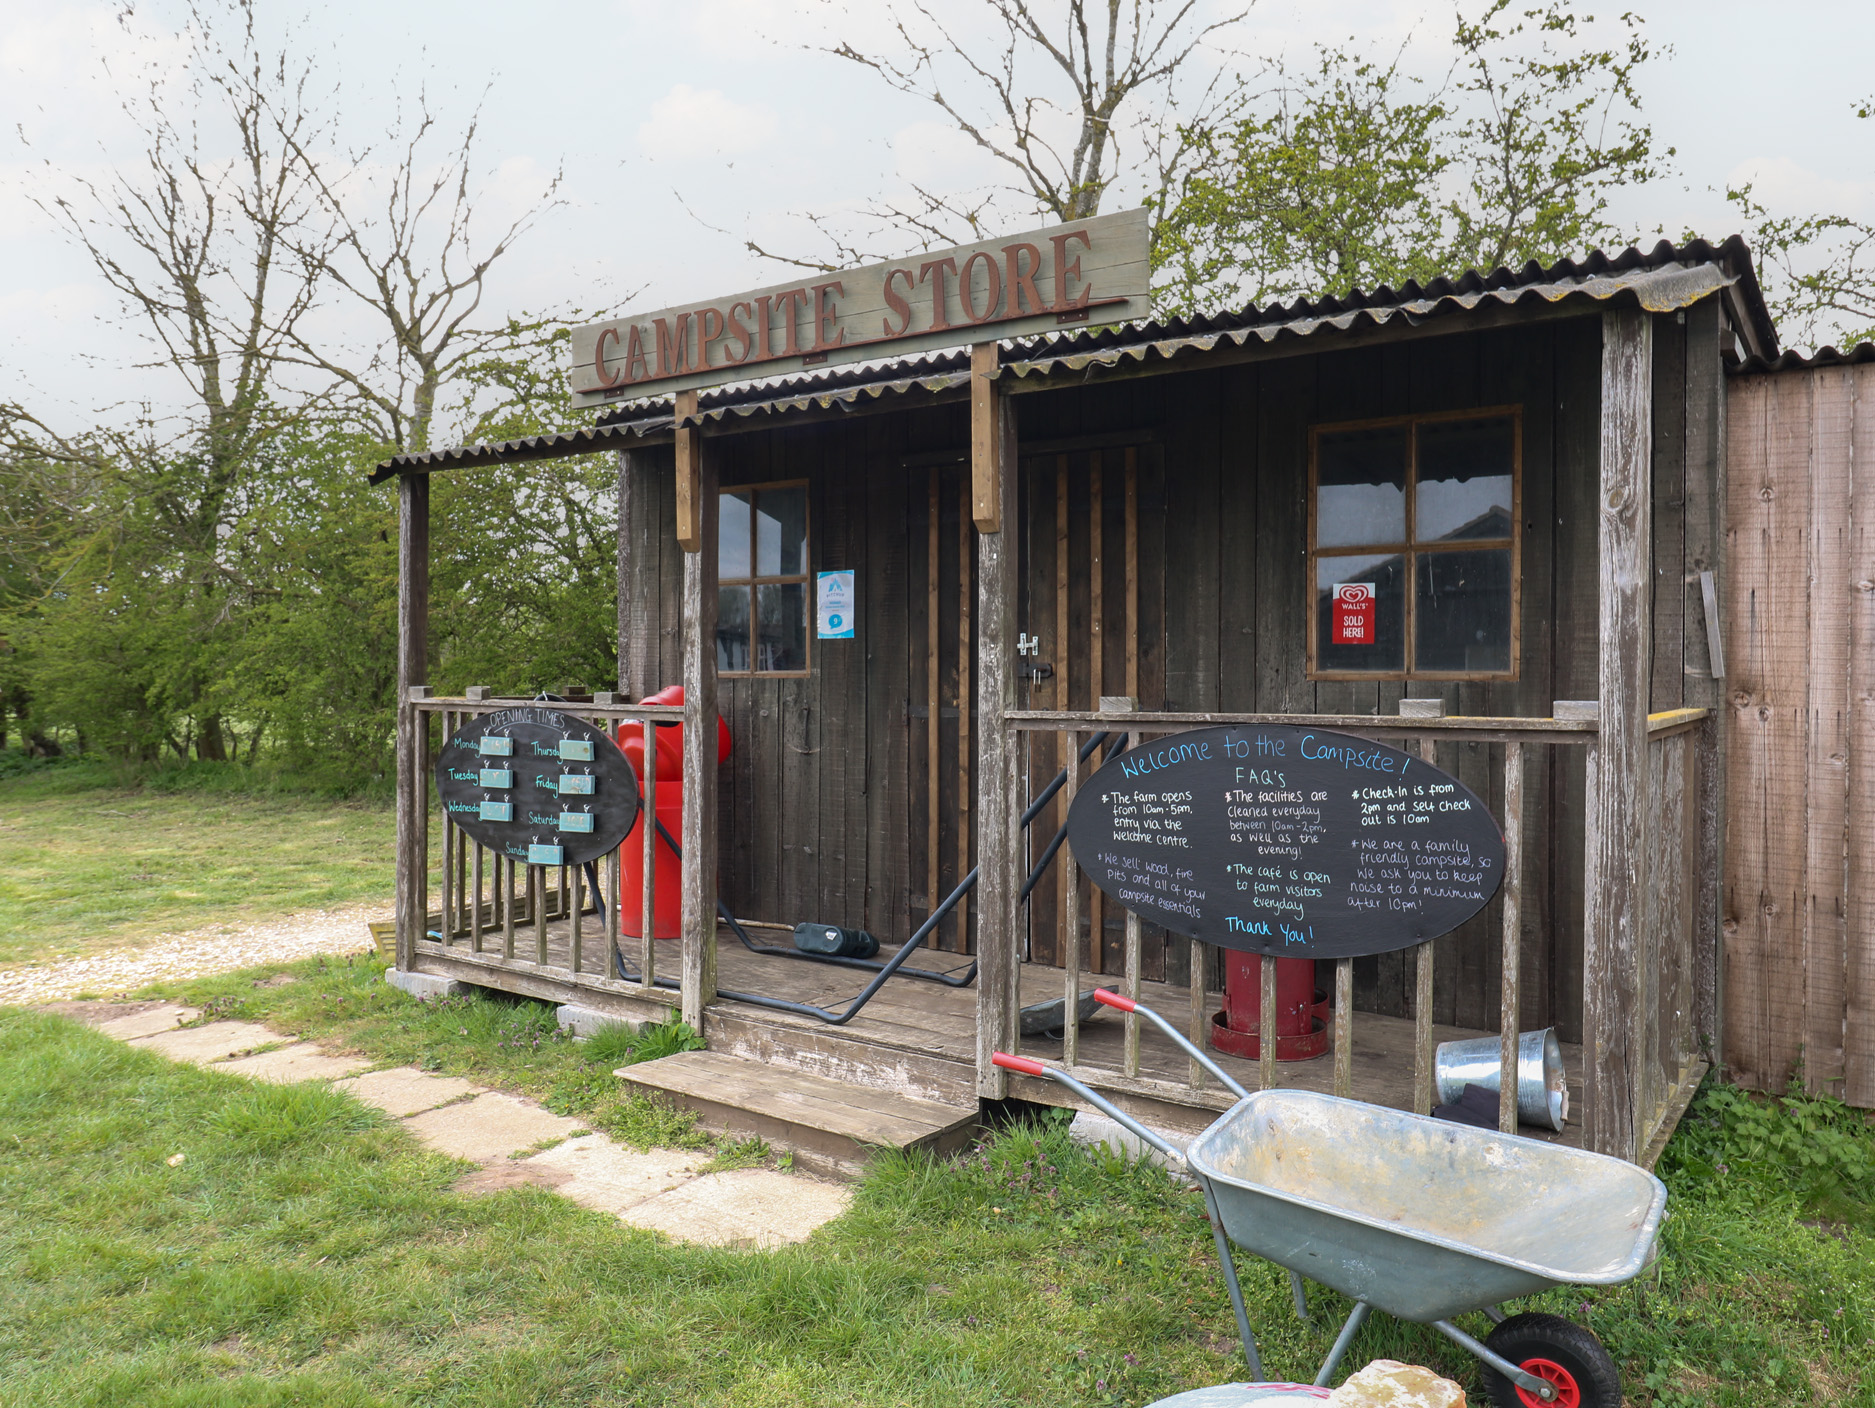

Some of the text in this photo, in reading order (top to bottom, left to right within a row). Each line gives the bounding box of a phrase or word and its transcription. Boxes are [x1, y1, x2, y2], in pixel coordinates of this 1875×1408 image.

[595, 229, 1092, 386] CAMPSITE STORE
[1343, 615, 1364, 626] SOLD
[1343, 627, 1364, 638] HERE!
[490, 708, 565, 728] OPENING TIMES
[454, 738, 480, 758] Monday
[531, 741, 563, 764] Thursda
[1121, 743, 1212, 779] Welcome
[1224, 736, 1249, 758] to
[1255, 735, 1286, 757] the
[448, 768, 478, 786] Tuesday
[536, 775, 558, 799] Friday
[1414, 785, 1424, 795] is
[1429, 784, 1454, 796] from
[1111, 790, 1192, 803] The farm opens
[1233, 790, 1327, 803] The facilities are
[449, 800, 482, 821] Wednesda
[1113, 805, 1137, 816] from
[1272, 805, 1320, 824] everyday
[1361, 803, 1380, 814] 2pm
[1387, 802, 1406, 811] and
[1114, 817, 1182, 834] entry via the
[1230, 820, 1266, 831] between
[1361, 814, 1429, 826] out is 10am
[1230, 833, 1242, 842] as
[1278, 833, 1291, 843] as
[1299, 834, 1318, 844] the
[1258, 846, 1302, 860] evening!
[1361, 839, 1470, 863] We are a family
[1105, 852, 1118, 865] We
[1176, 868, 1193, 881] fire
[1360, 852, 1409, 869] friendly
[1479, 857, 1491, 867] so
[1233, 864, 1330, 883] The café is open
[1381, 868, 1401, 878] ask
[1408, 870, 1431, 885] you
[1436, 870, 1448, 880] to
[1454, 870, 1482, 885] keep
[1133, 874, 1150, 886] and
[1155, 880, 1167, 891] all
[1171, 883, 1181, 895] of
[1184, 888, 1205, 903] your
[1236, 879, 1322, 897] to farm visitors
[1351, 882, 1484, 900] noise to a minimum
[1158, 898, 1200, 918] essentials
[1253, 897, 1304, 921] everyday
[1347, 897, 1380, 910] after
[1225, 916, 1272, 935] Thank
